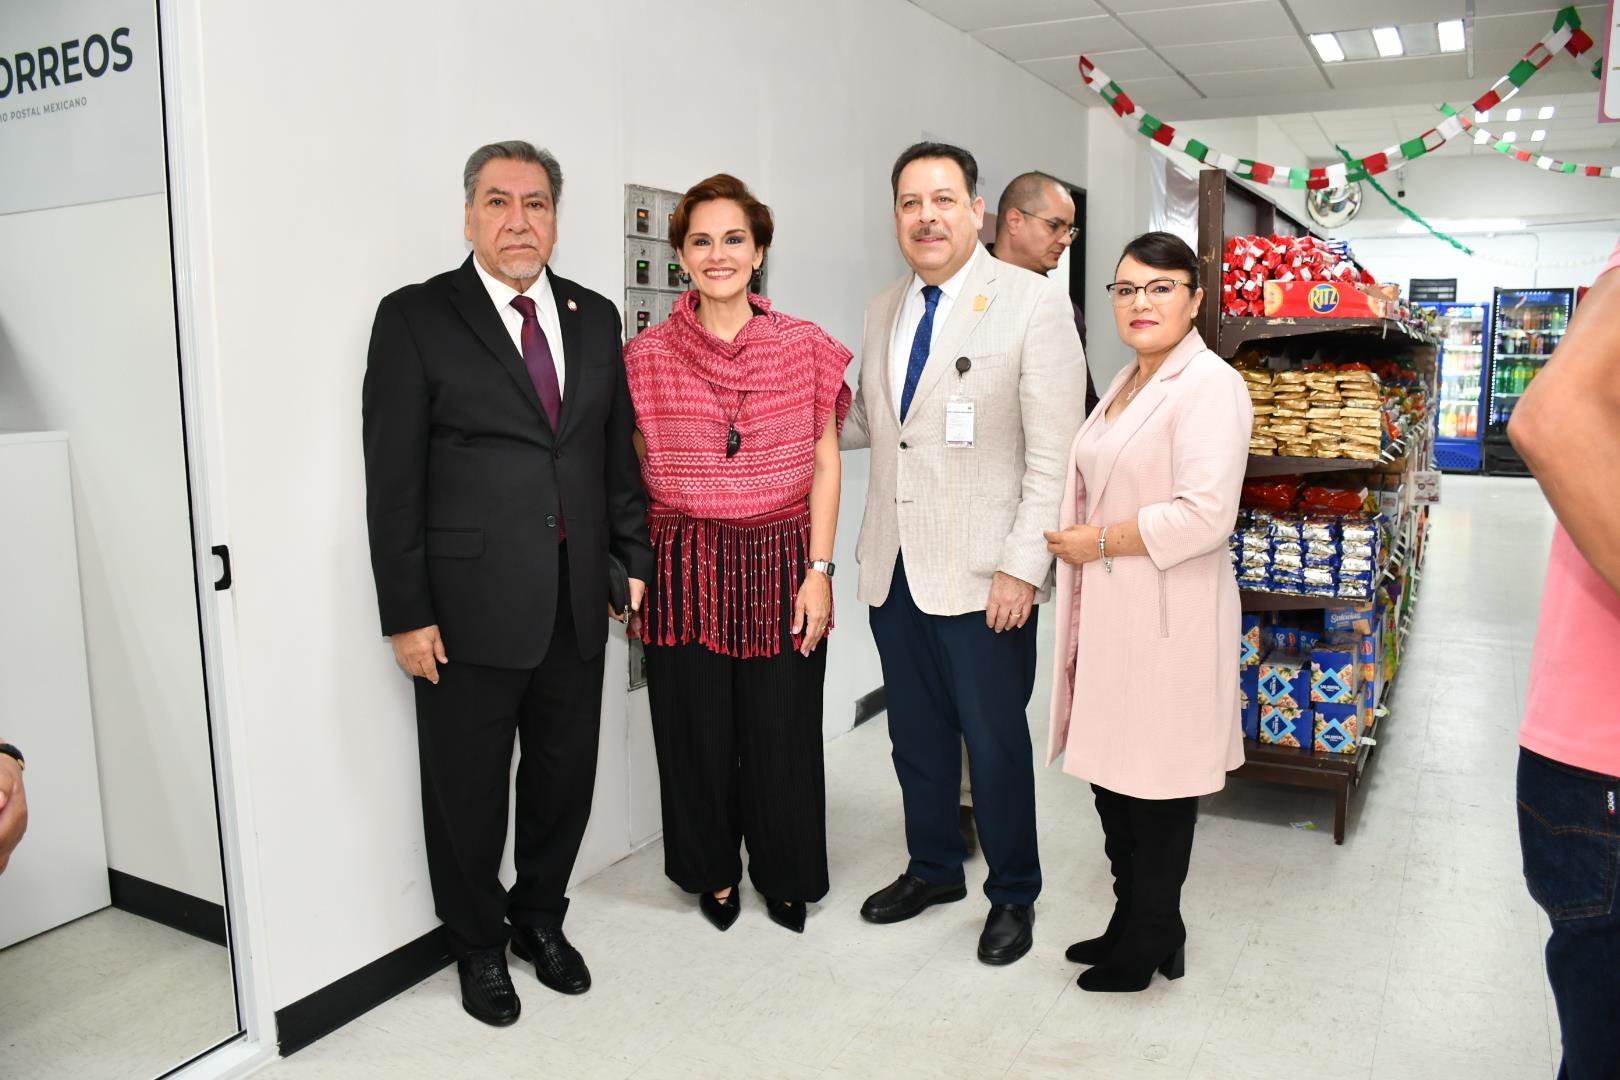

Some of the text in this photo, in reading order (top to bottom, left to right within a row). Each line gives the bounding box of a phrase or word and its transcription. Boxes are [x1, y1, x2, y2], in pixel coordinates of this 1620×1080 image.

[10, 106, 41, 121] POSTAL
[43, 96, 88, 114] MEXICANO
[1309, 286, 1338, 310] RITZ
